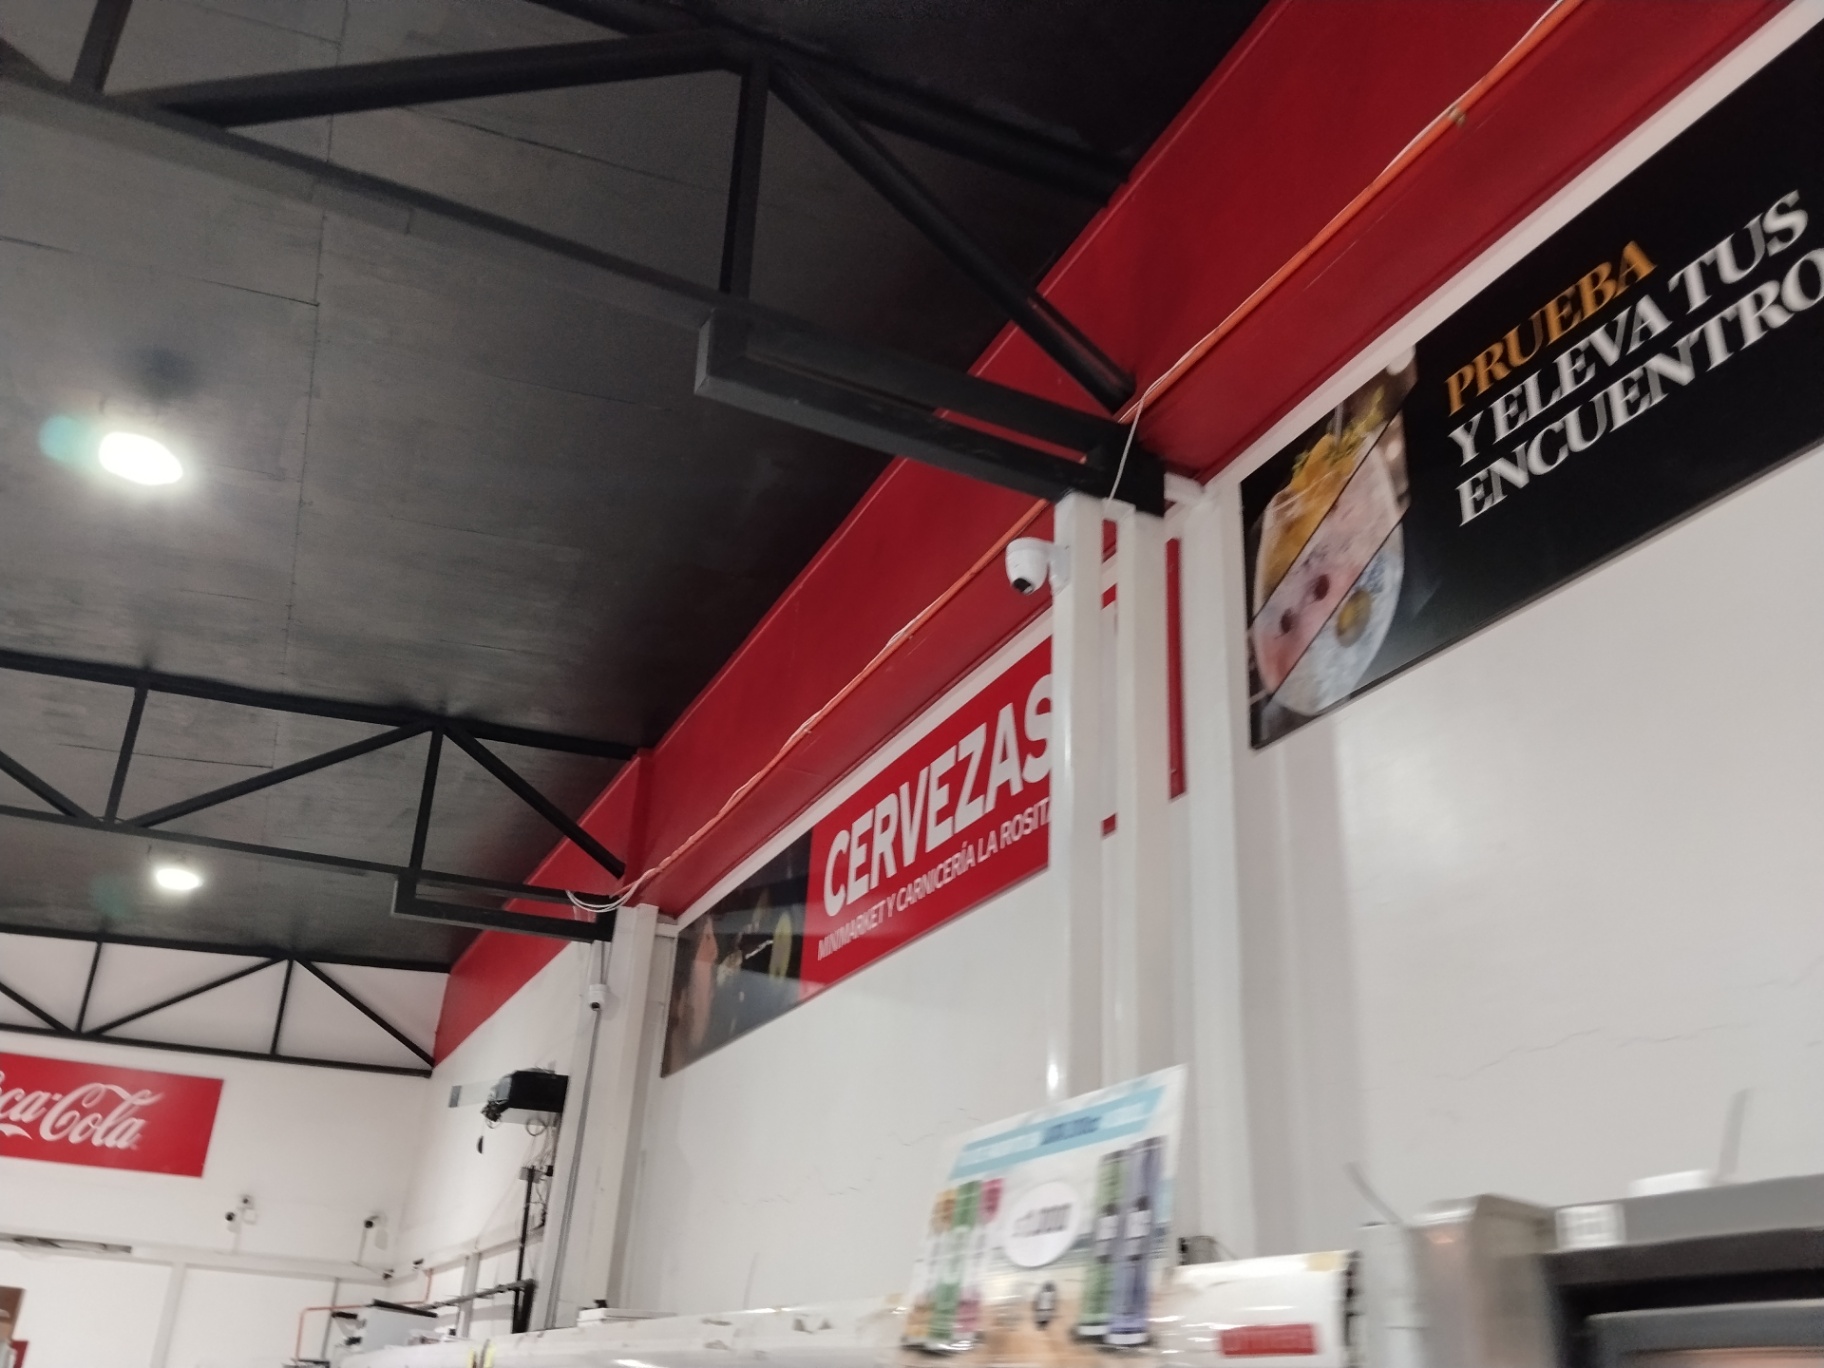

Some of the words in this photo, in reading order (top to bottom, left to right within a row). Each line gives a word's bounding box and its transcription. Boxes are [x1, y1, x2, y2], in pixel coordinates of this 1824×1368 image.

[1445, 240, 1657, 416] PRUEBA
[1448, 411, 1484, 467] Y
[1488, 294, 1673, 445] ELEVA
[1668, 190, 1808, 315] TUS
[1455, 248, 1824, 527] ENCUENTRO
[818, 900, 886, 961] MINIMARKET
[886, 893, 897, 918] Y
[896, 841, 976, 912] CARNICERÍA
[978, 829, 999, 864] LA
[823, 673, 1051, 917] CERVEZAS
